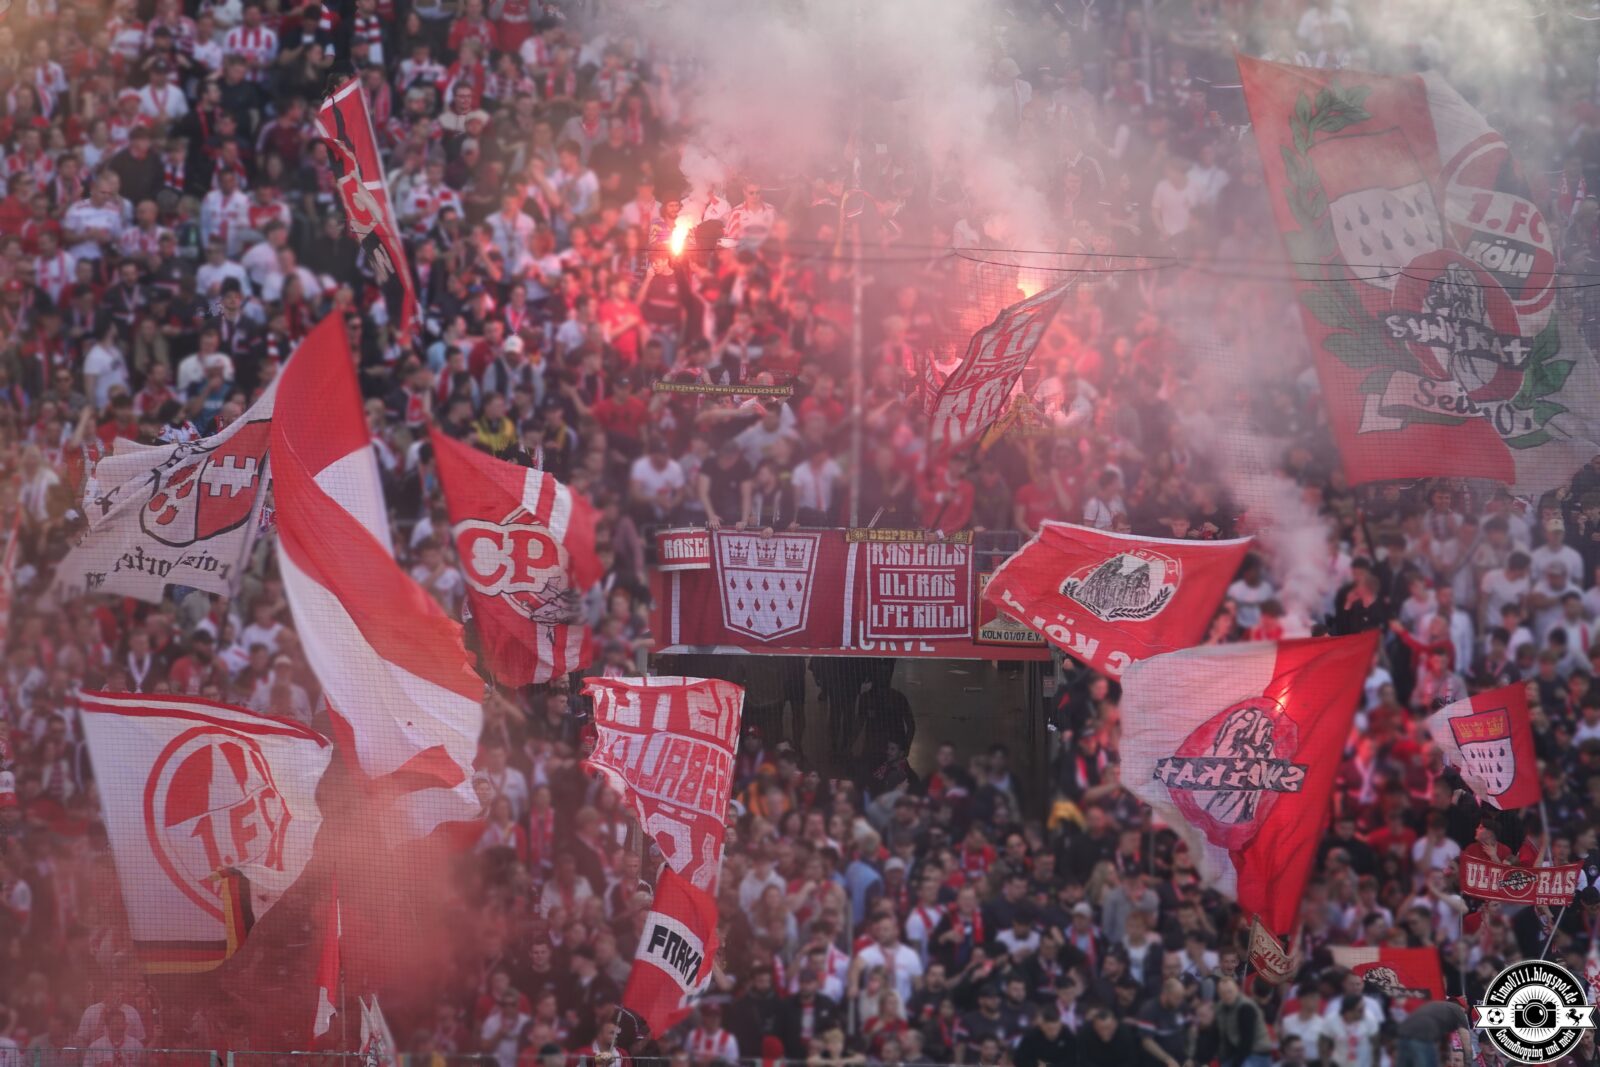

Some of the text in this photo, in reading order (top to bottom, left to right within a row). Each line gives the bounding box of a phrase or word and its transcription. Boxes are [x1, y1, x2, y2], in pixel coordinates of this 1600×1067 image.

[1467, 239, 1535, 278] KÖLN
[456, 528, 560, 587] CP
[664, 537, 710, 559] RASCA
[871, 543, 966, 566] RASCALS
[879, 573, 956, 597] ULTRAS
[913, 603, 965, 629] KÖLN
